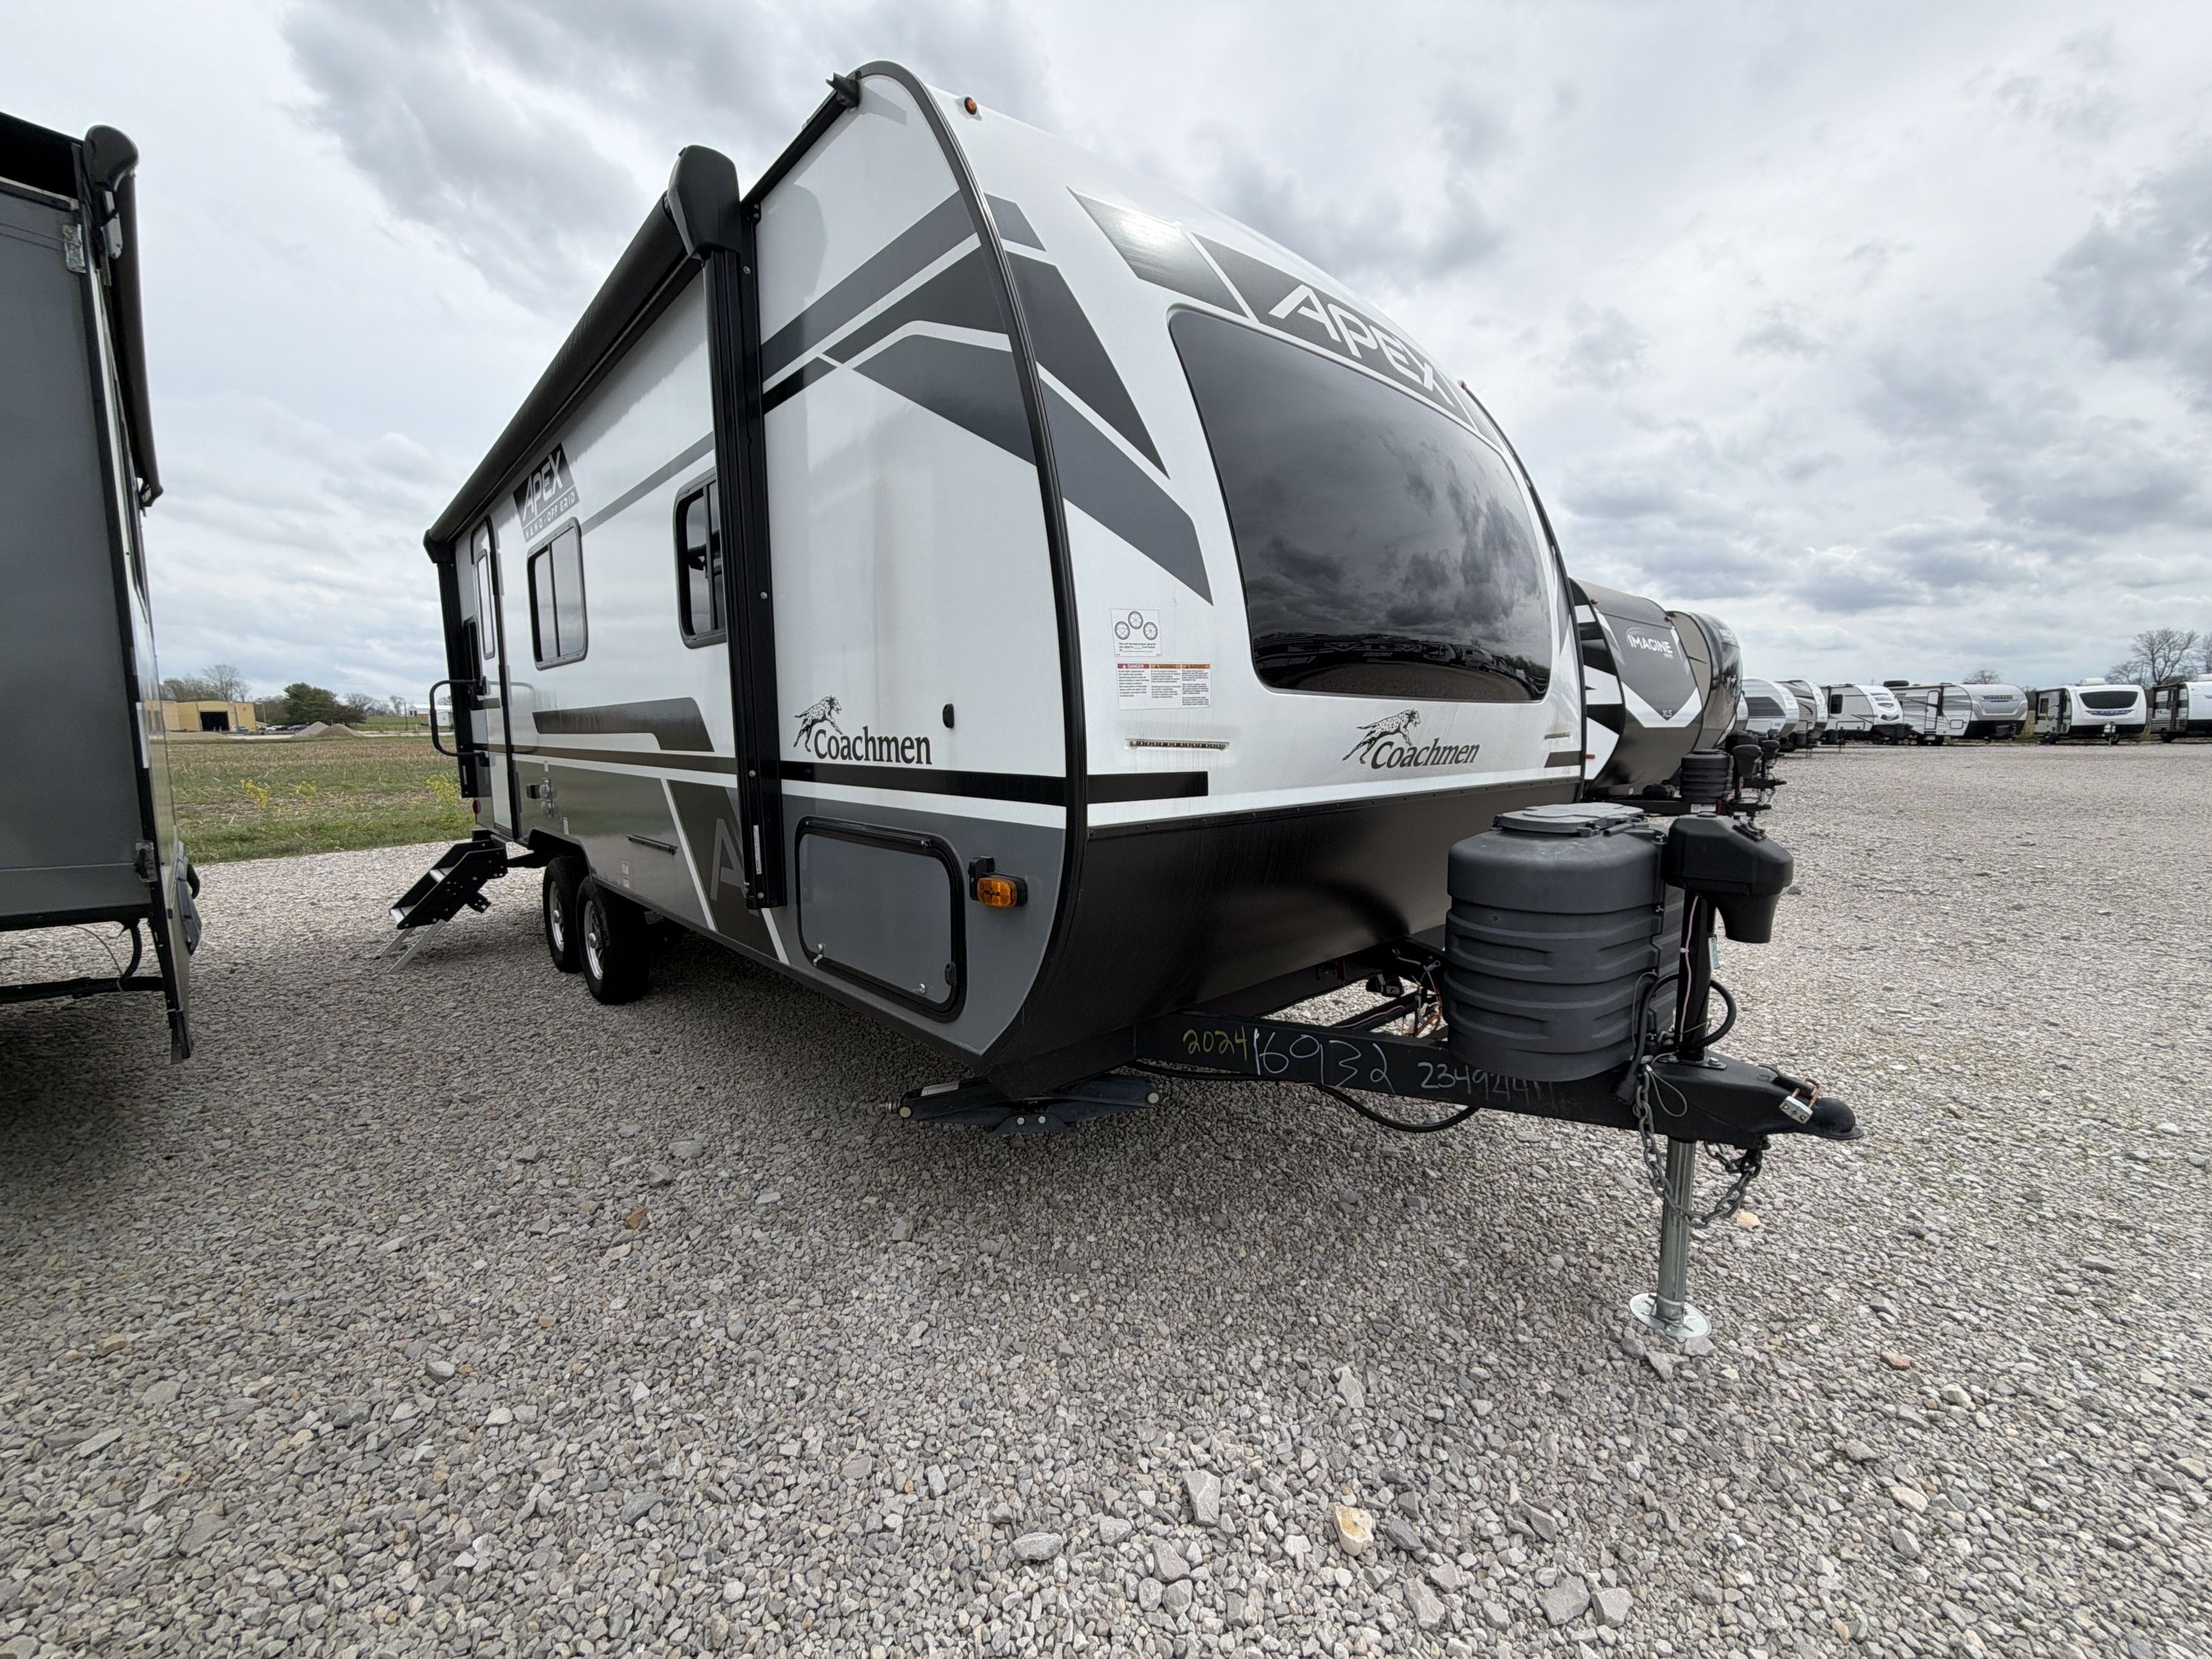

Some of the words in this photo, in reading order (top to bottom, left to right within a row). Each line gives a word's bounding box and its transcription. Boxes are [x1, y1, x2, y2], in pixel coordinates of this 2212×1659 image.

[1267, 284, 1455, 408] APEX
[523, 450, 563, 522] APEX
[547, 504, 558, 522] OFF
[560, 492, 575, 512] GRID
[1627, 634, 1673, 654] IMAGINE
[1662, 709, 1672, 717] XLS
[814, 725, 933, 765] Coachmen
[1371, 737, 1481, 770] Coachmen
[1183, 1026, 1248, 1062] 2024
[1254, 1028, 1396, 1095] 16932
